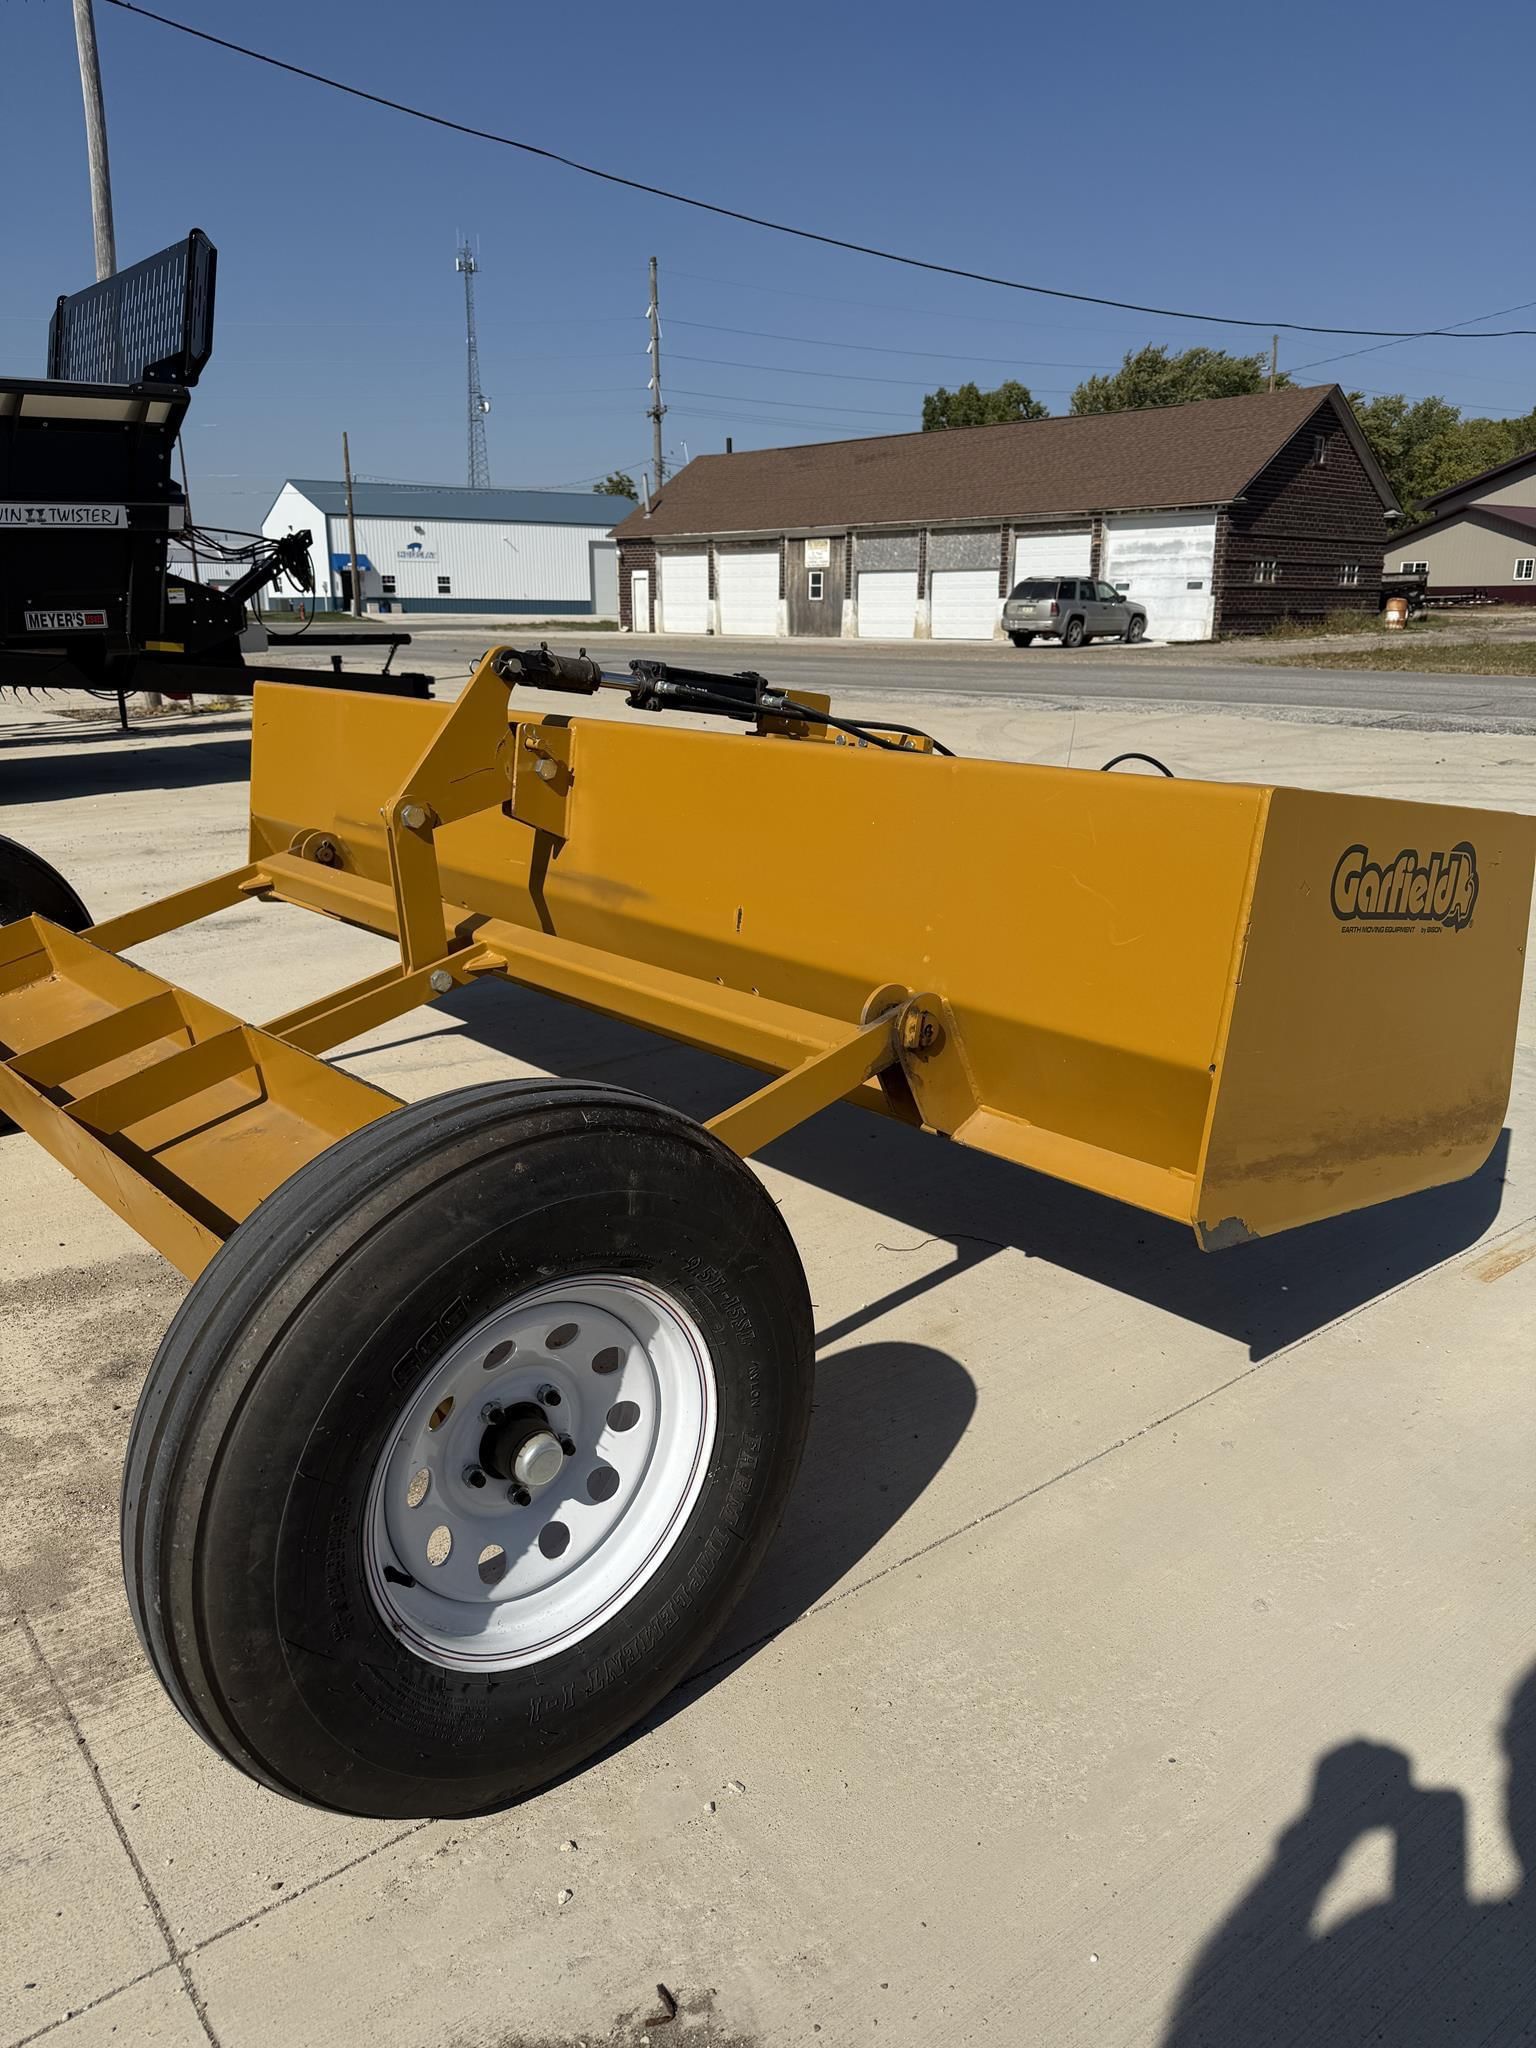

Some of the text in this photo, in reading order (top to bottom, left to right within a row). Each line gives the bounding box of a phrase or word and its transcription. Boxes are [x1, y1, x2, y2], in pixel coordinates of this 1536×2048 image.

[0, 508, 112, 523] IN TWISTER
[29, 612, 84, 628] MEYER'S
[1331, 843, 1466, 924] Garfield
[719, 1431, 763, 1528] FARM
[585, 1526, 730, 1697] IMPLEMENT
